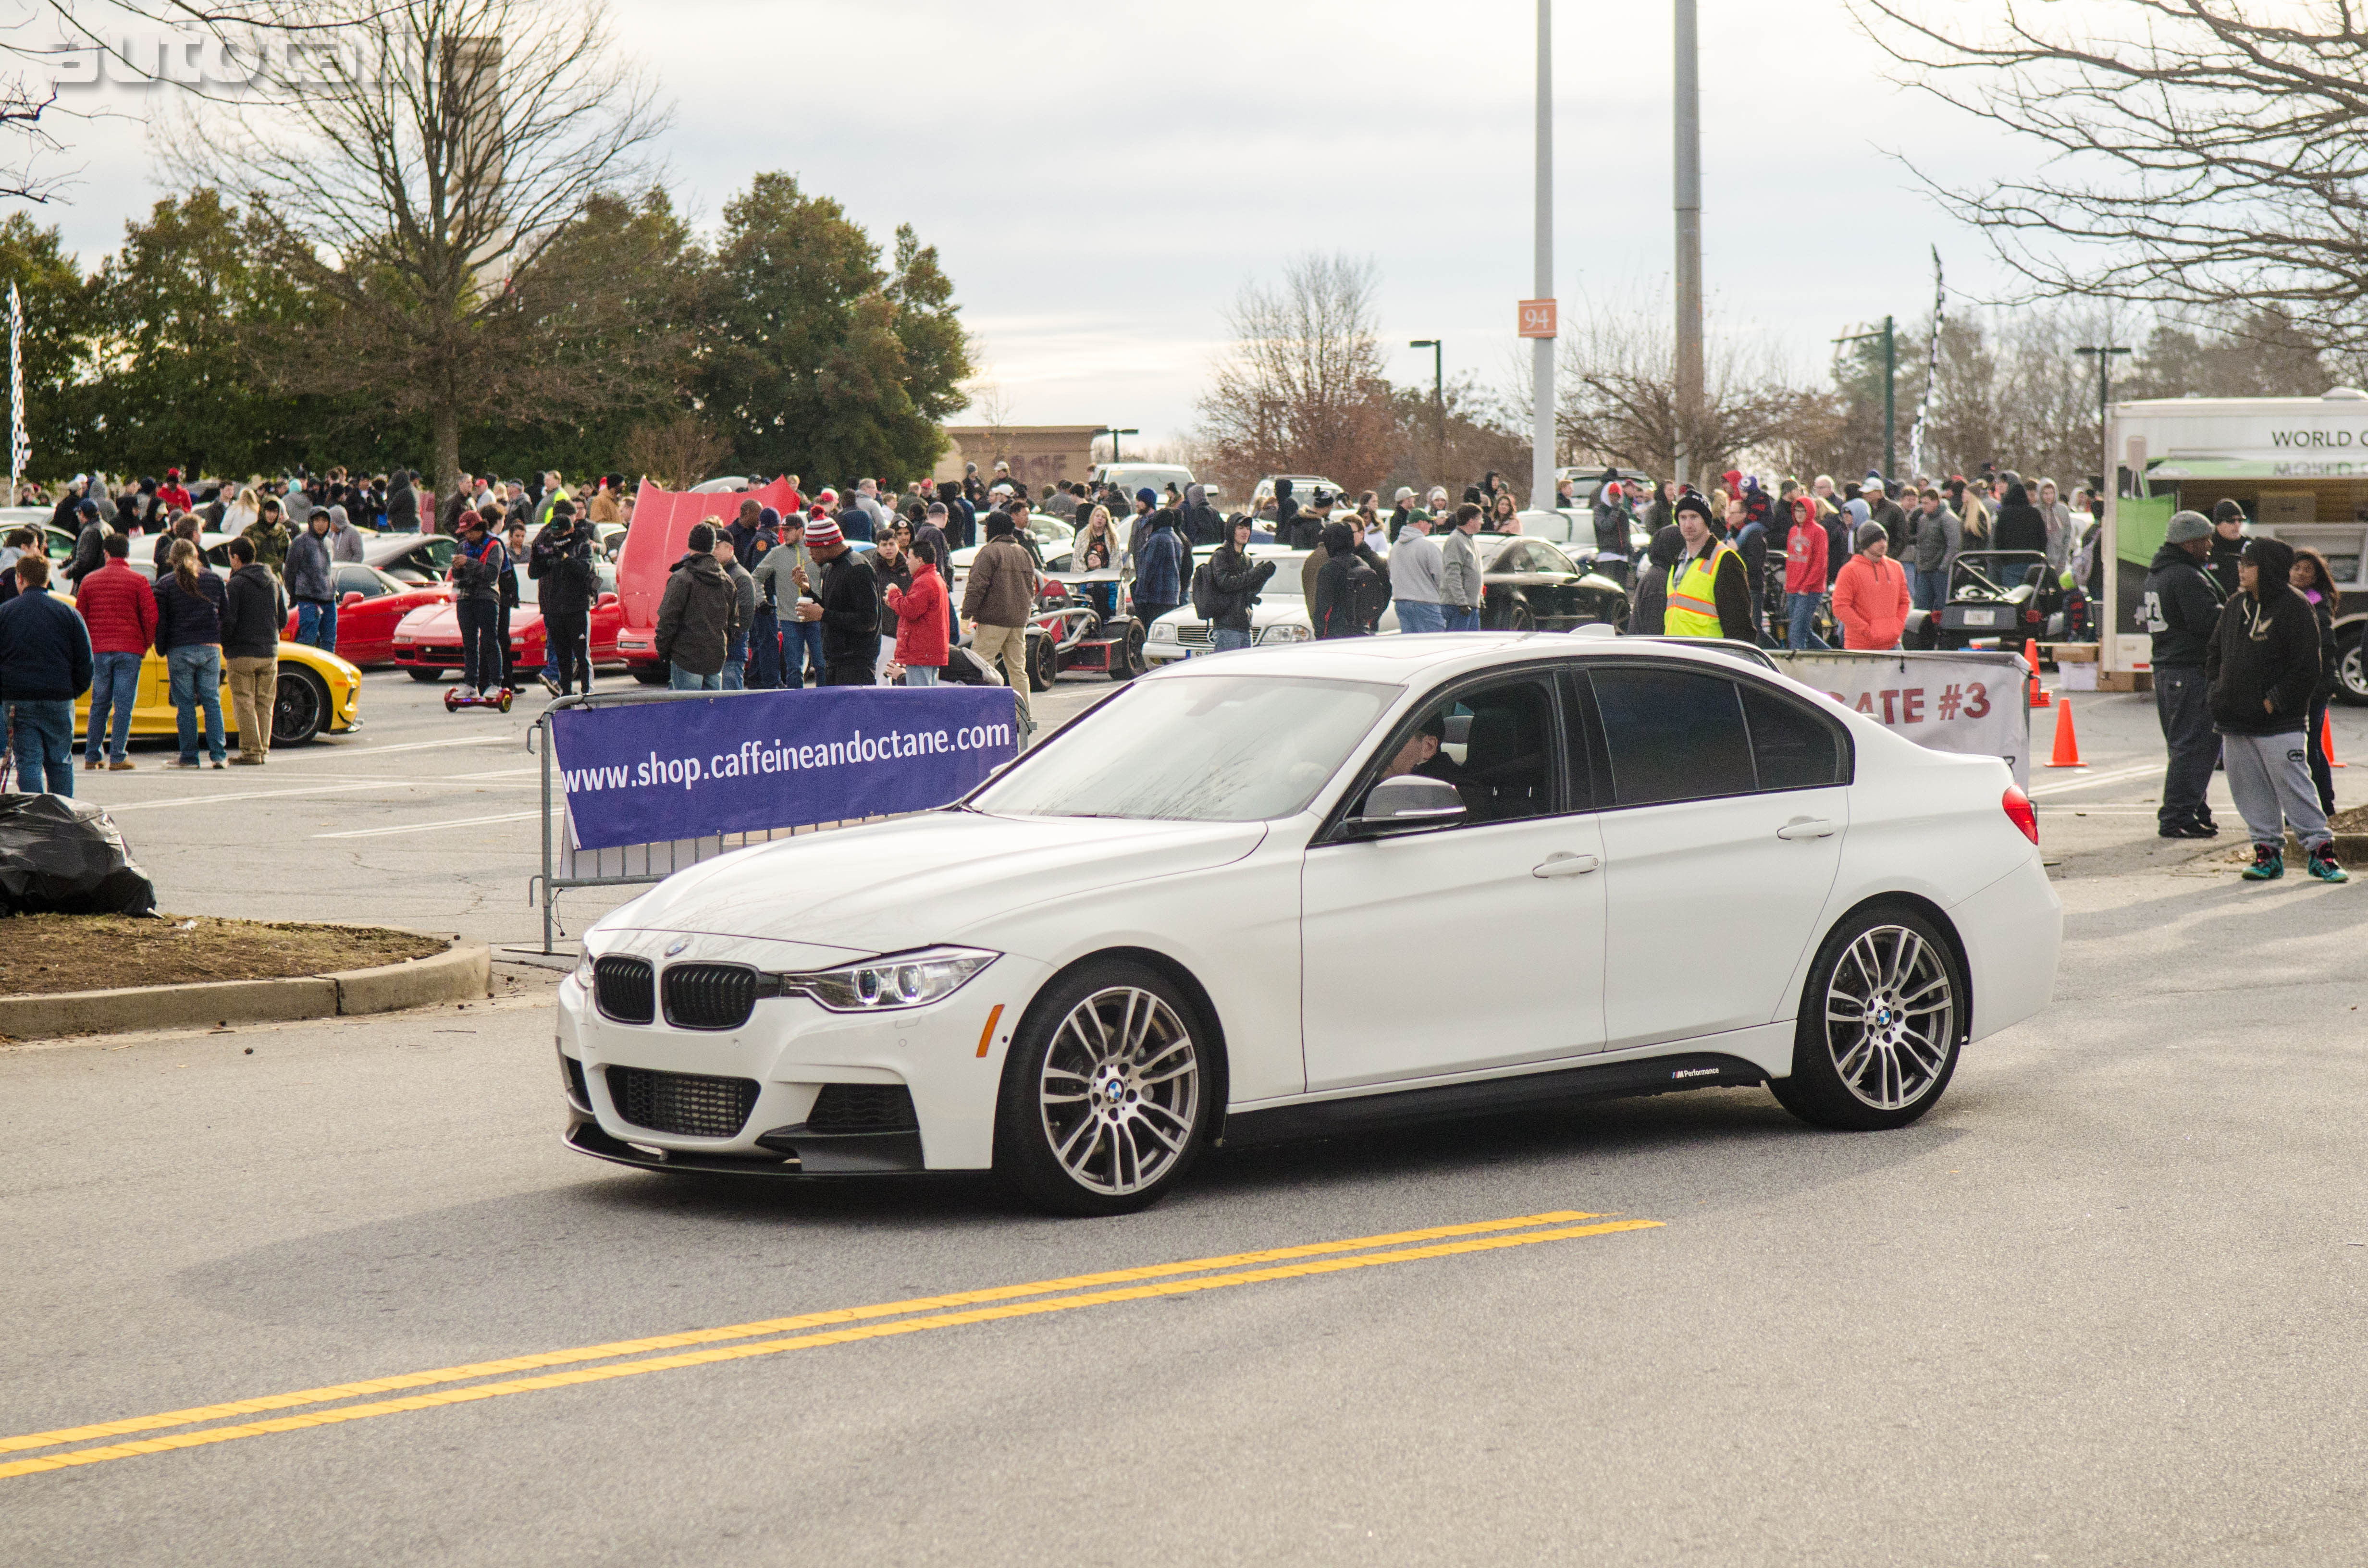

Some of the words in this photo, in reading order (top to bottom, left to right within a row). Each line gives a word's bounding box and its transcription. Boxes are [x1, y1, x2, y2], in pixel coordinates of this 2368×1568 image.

[1524, 308, 1549, 330] 94
[2272, 430, 2352, 447] WORLD
[1938, 682, 1991, 721] #3
[561, 723, 1010, 793] www.shop.caffeineandoctane.com
[1684, 1067, 1719, 1078] Performance
